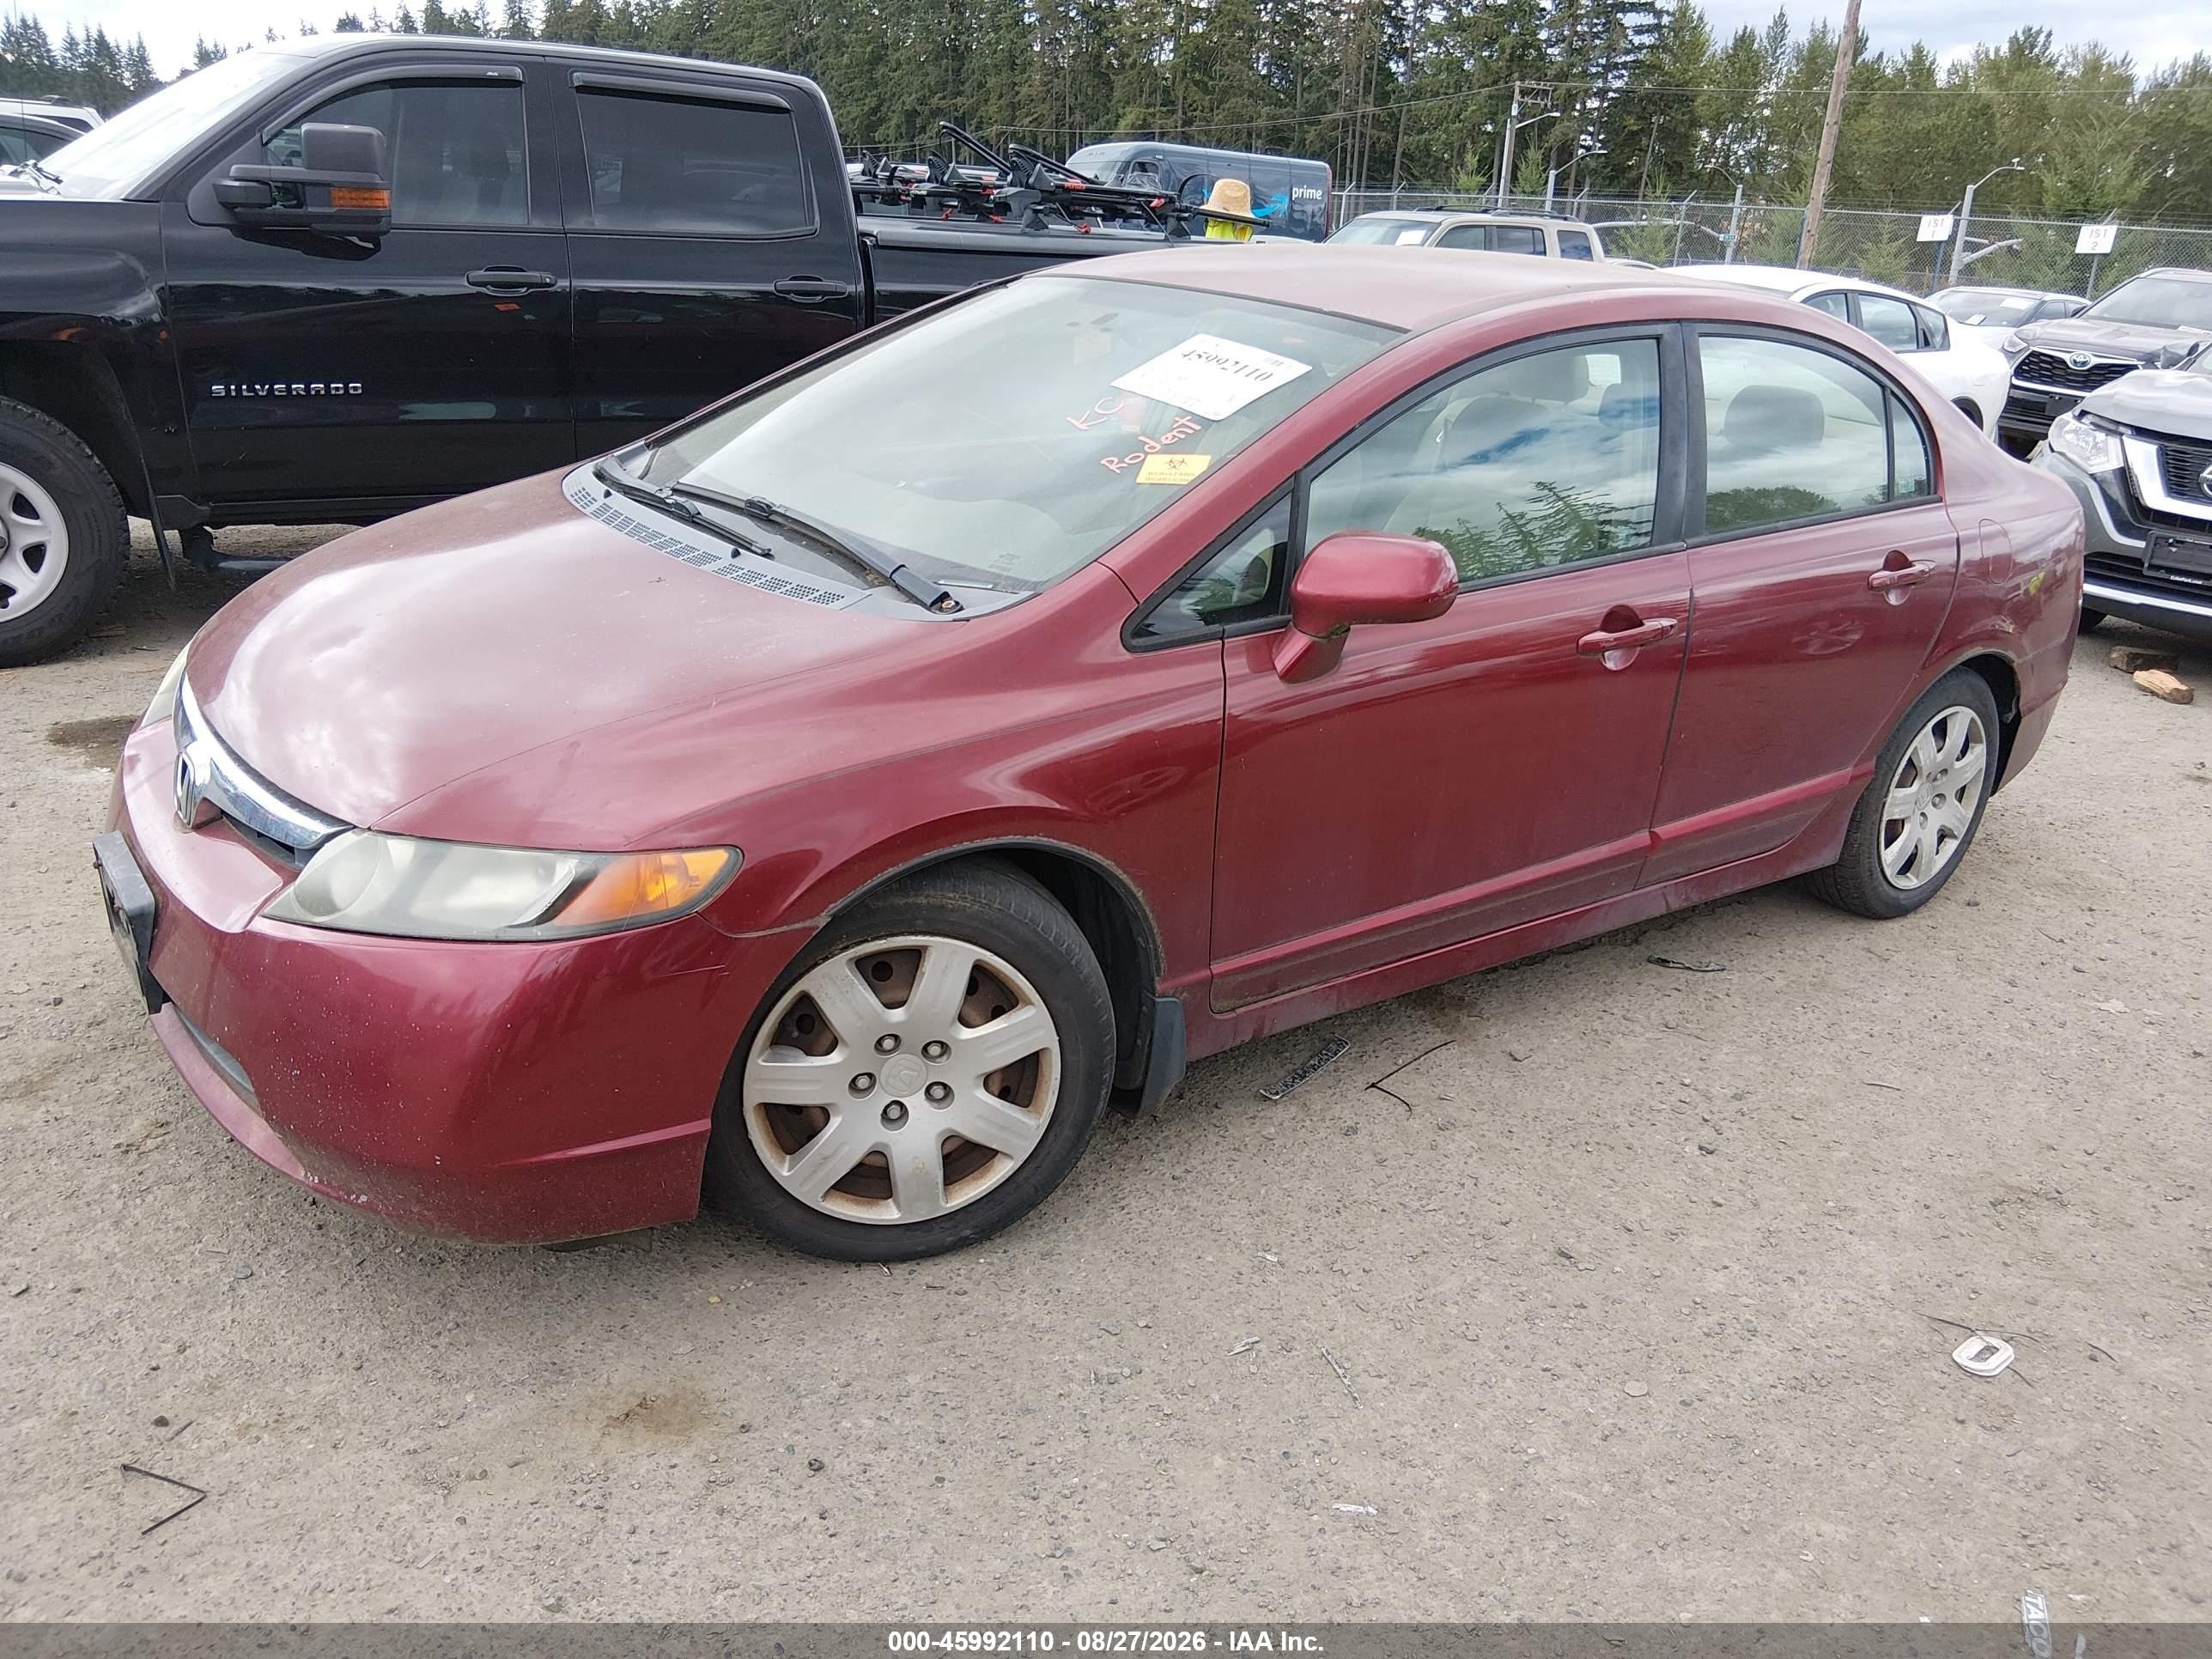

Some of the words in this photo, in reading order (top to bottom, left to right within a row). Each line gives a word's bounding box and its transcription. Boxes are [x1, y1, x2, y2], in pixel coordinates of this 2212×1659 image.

[1291, 185, 1322, 201] prime
[1181, 349, 1273, 381] 45992110
[211, 383, 362, 397] SILVERADO
[1100, 416, 1202, 474] Rodent
